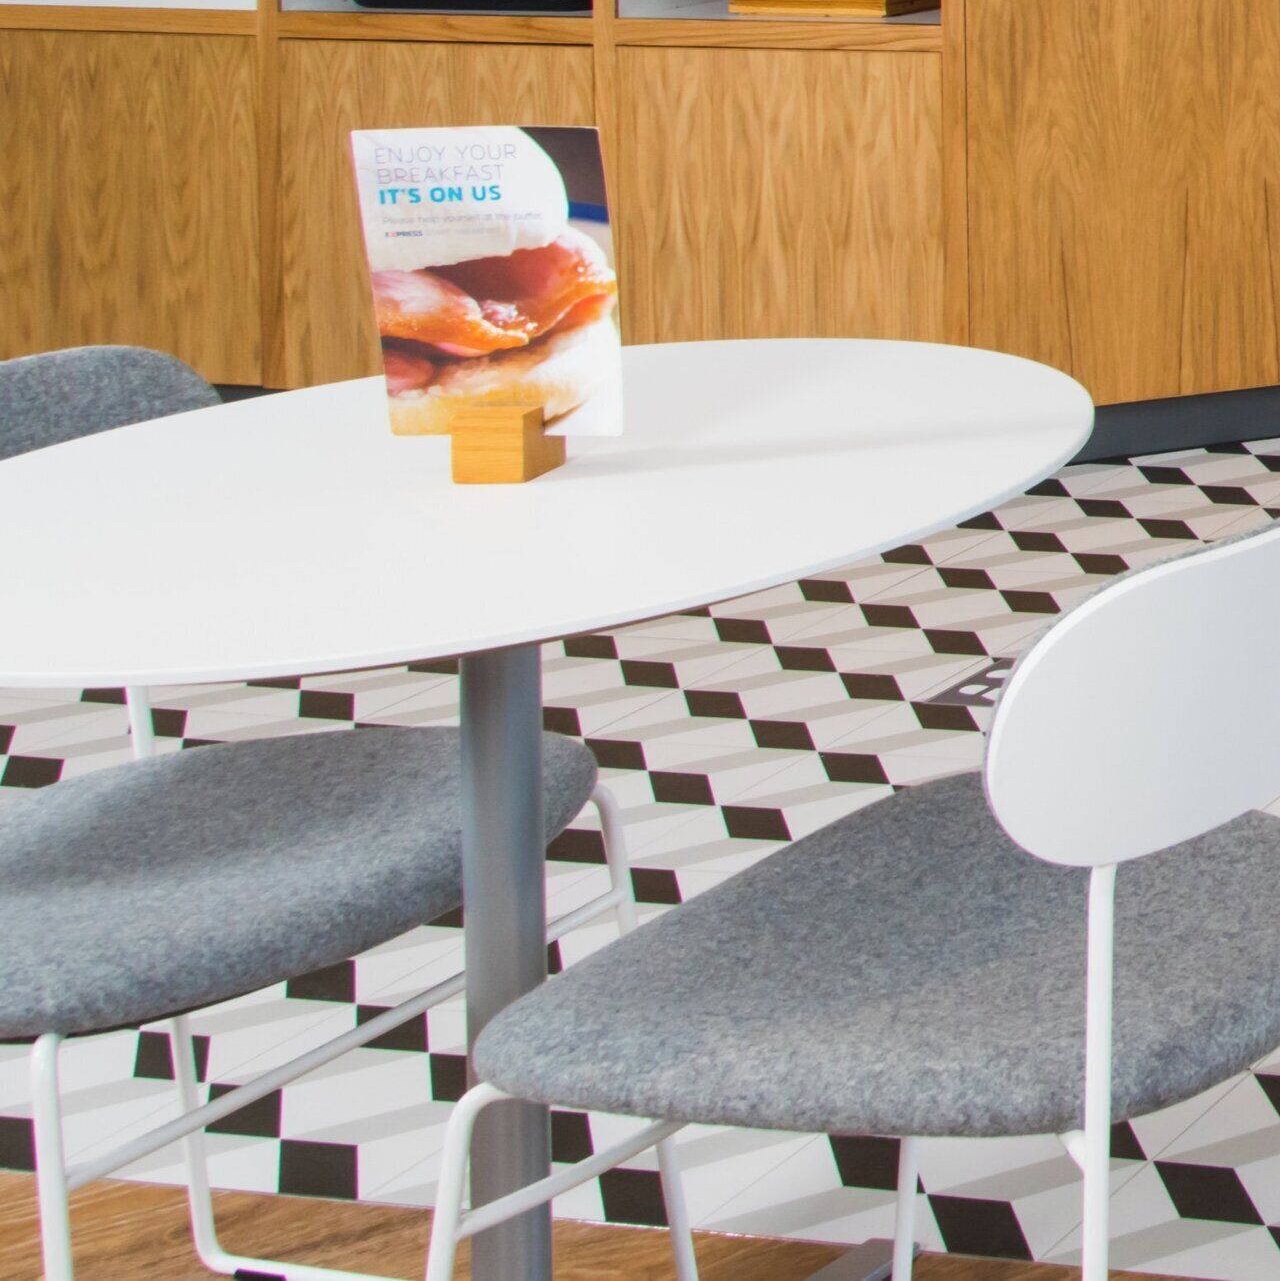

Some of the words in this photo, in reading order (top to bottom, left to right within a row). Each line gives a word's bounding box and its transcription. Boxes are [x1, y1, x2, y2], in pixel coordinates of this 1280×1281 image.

[373, 146, 447, 165] ENJOY
[454, 143, 518, 162] YOUR
[375, 164, 505, 185] BREAKFAST
[378, 186, 422, 205] IT'S
[429, 186, 463, 203] ON
[471, 185, 502, 202] US
